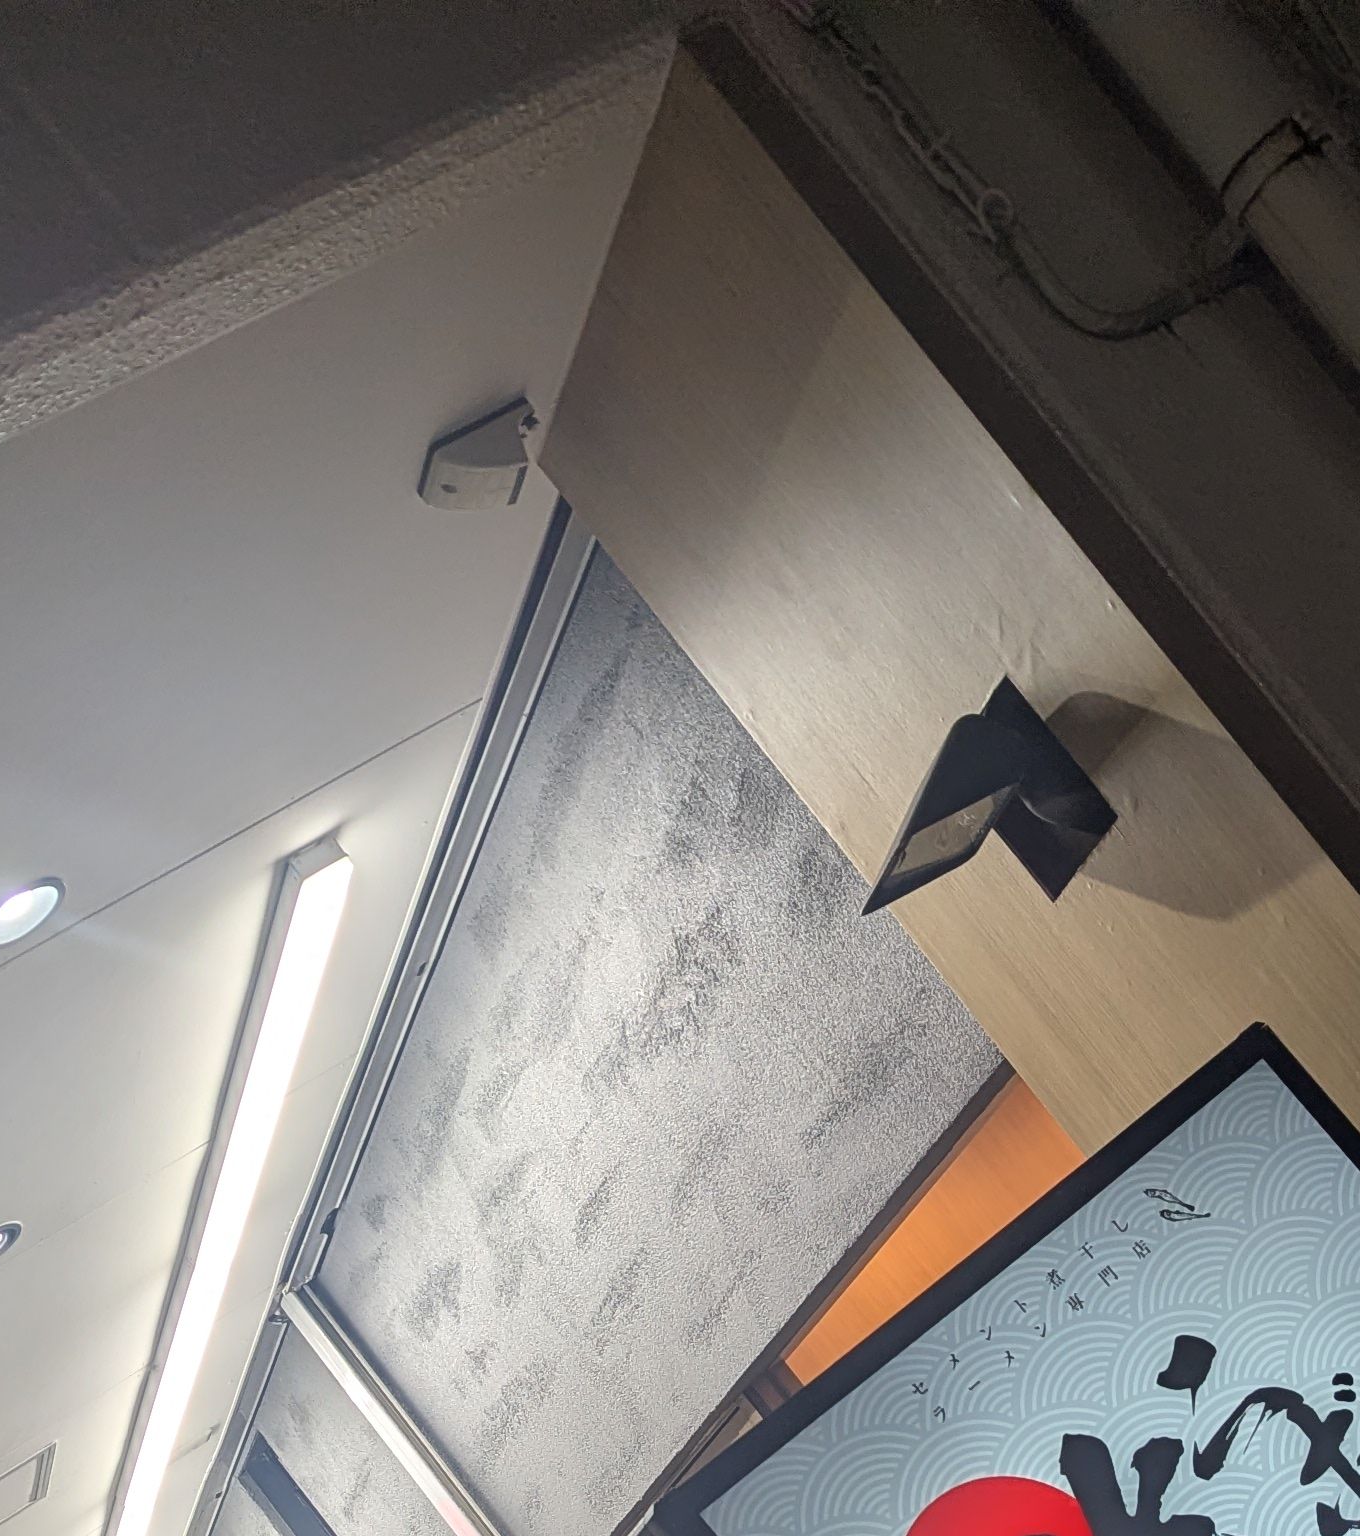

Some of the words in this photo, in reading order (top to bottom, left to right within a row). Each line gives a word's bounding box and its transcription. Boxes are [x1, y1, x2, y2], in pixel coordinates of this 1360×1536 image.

[910, 1217, 1131, 1399] セメント煮干し
[930, 1238, 1152, 1422] ラーメン専門店
